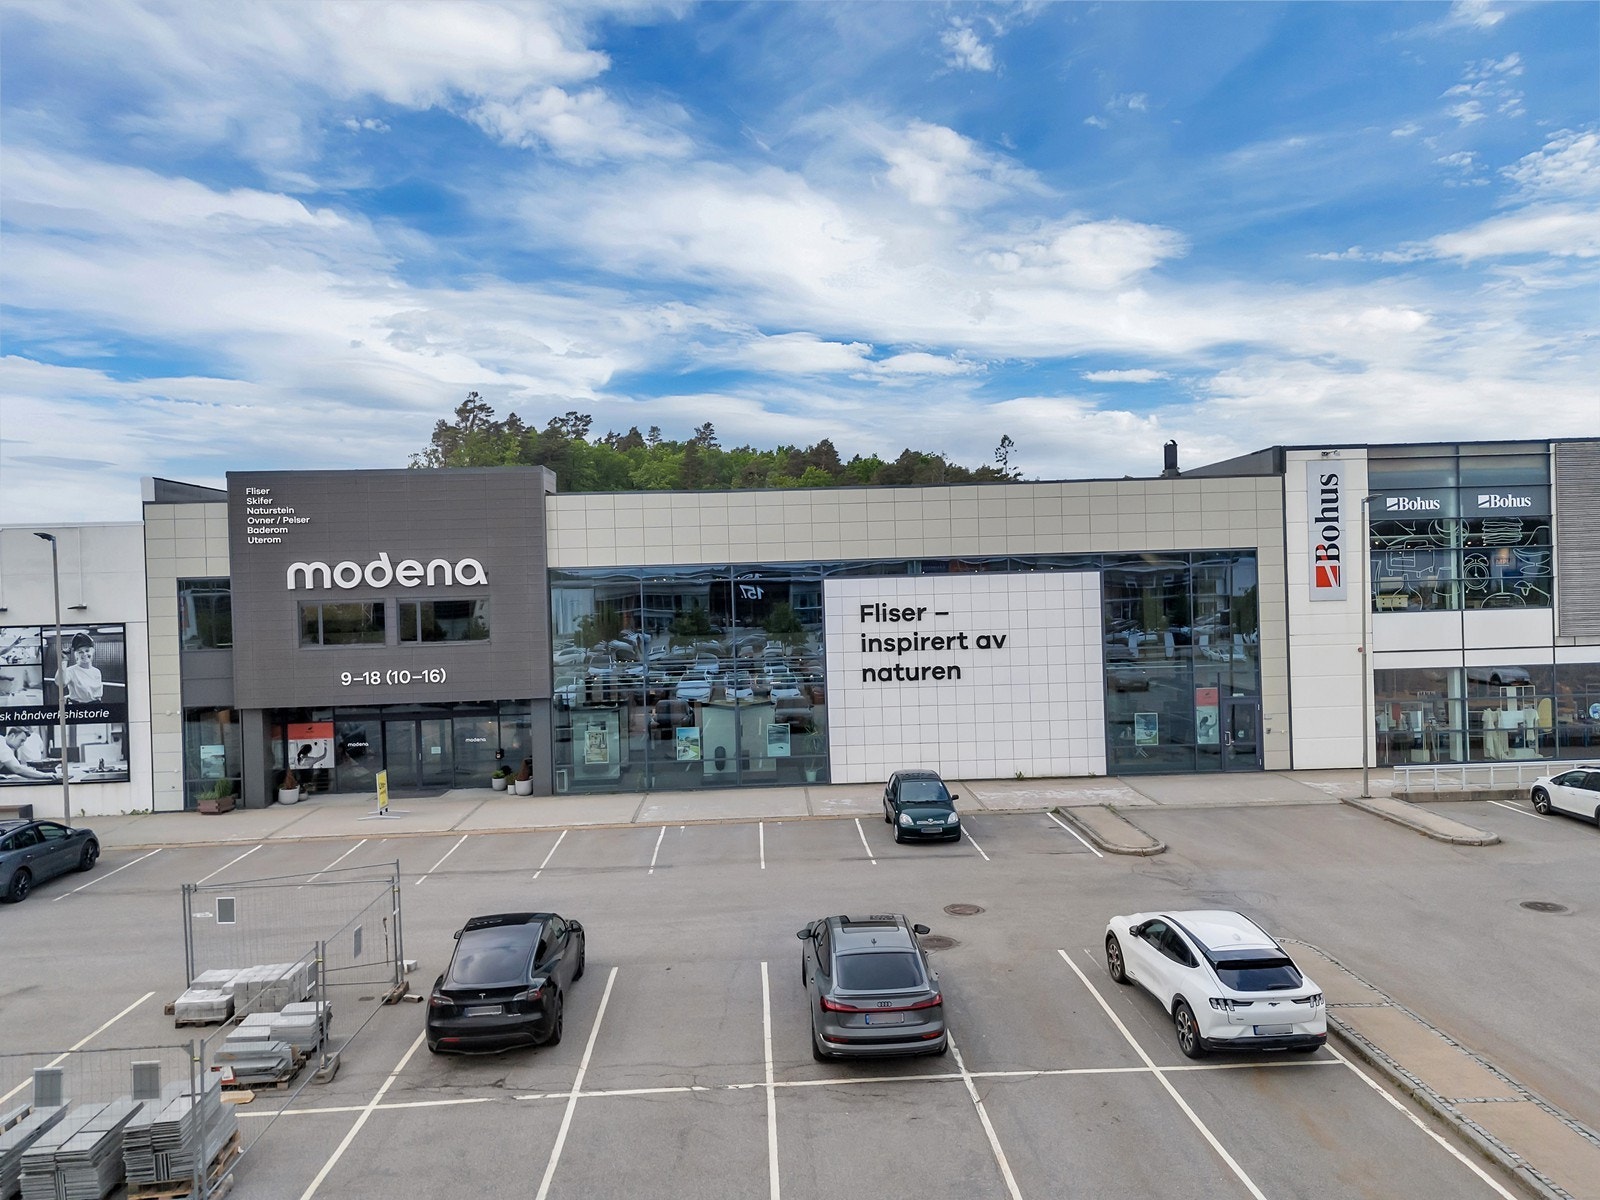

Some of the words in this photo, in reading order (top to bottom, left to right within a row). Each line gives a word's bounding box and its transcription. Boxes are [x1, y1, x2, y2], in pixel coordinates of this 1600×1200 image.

[245, 487, 270, 495] Fliser
[246, 497, 273, 505] Skifer
[1399, 496, 1440, 511] Bohus
[1490, 494, 1531, 508] Bohus
[246, 506, 295, 515] Naturstein
[247, 516, 275, 525] Ovner
[282, 516, 311, 524] Peiser
[1315, 473, 1340, 563] Bohus
[247, 526, 289, 534] Baderom
[247, 536, 282, 544] Uterom
[286, 552, 489, 590] modena
[860, 602, 927, 623] Fliser
[861, 631, 969, 656] inspirert
[975, 634, 1007, 650] av
[862, 663, 961, 682] naturen
